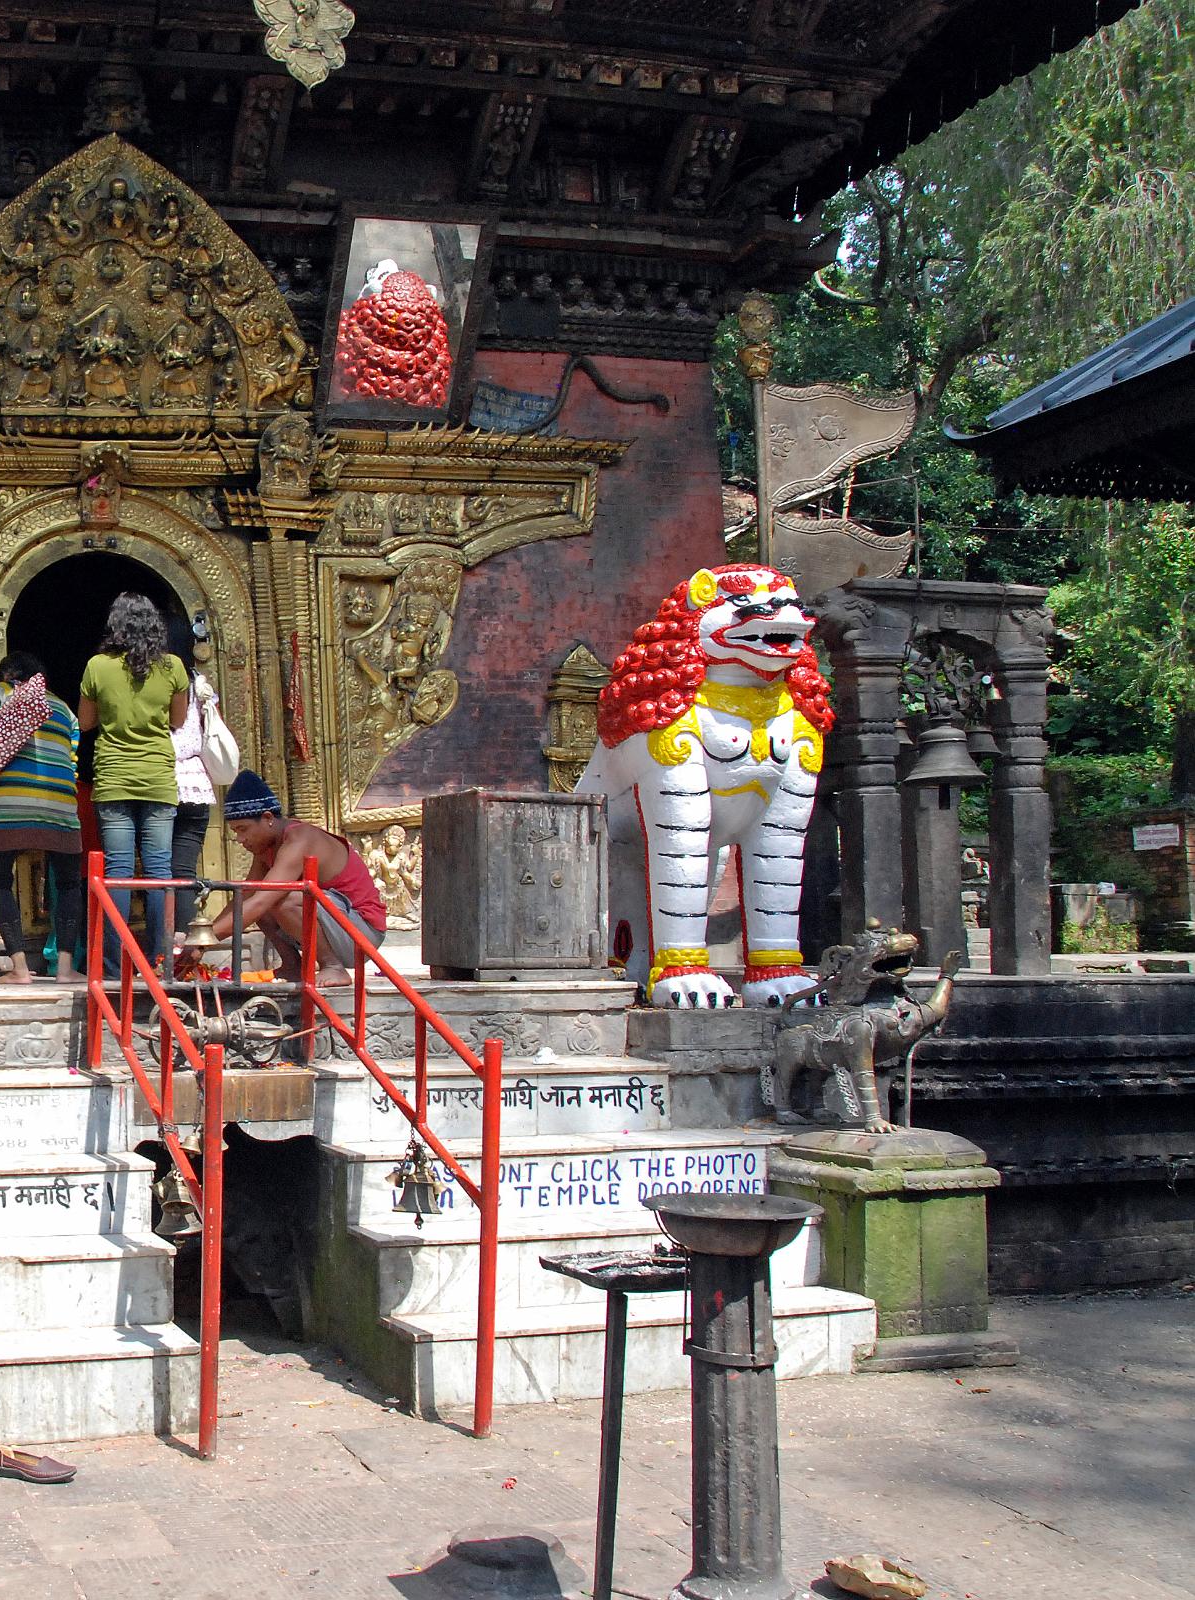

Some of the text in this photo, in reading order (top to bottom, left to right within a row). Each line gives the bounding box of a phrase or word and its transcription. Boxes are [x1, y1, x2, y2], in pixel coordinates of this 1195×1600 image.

[540, 1086, 584, 1108] जान
[588, 1076, 648, 1114] मनाही
[649, 1084, 665, 1116] छ
[551, 1158, 622, 1184] CLICK
[630, 1157, 675, 1178] THE
[685, 1152, 756, 1176] PHOTO
[15, 1176, 79, 1209] मनाही
[514, 1183, 620, 1208] TEMPLE
